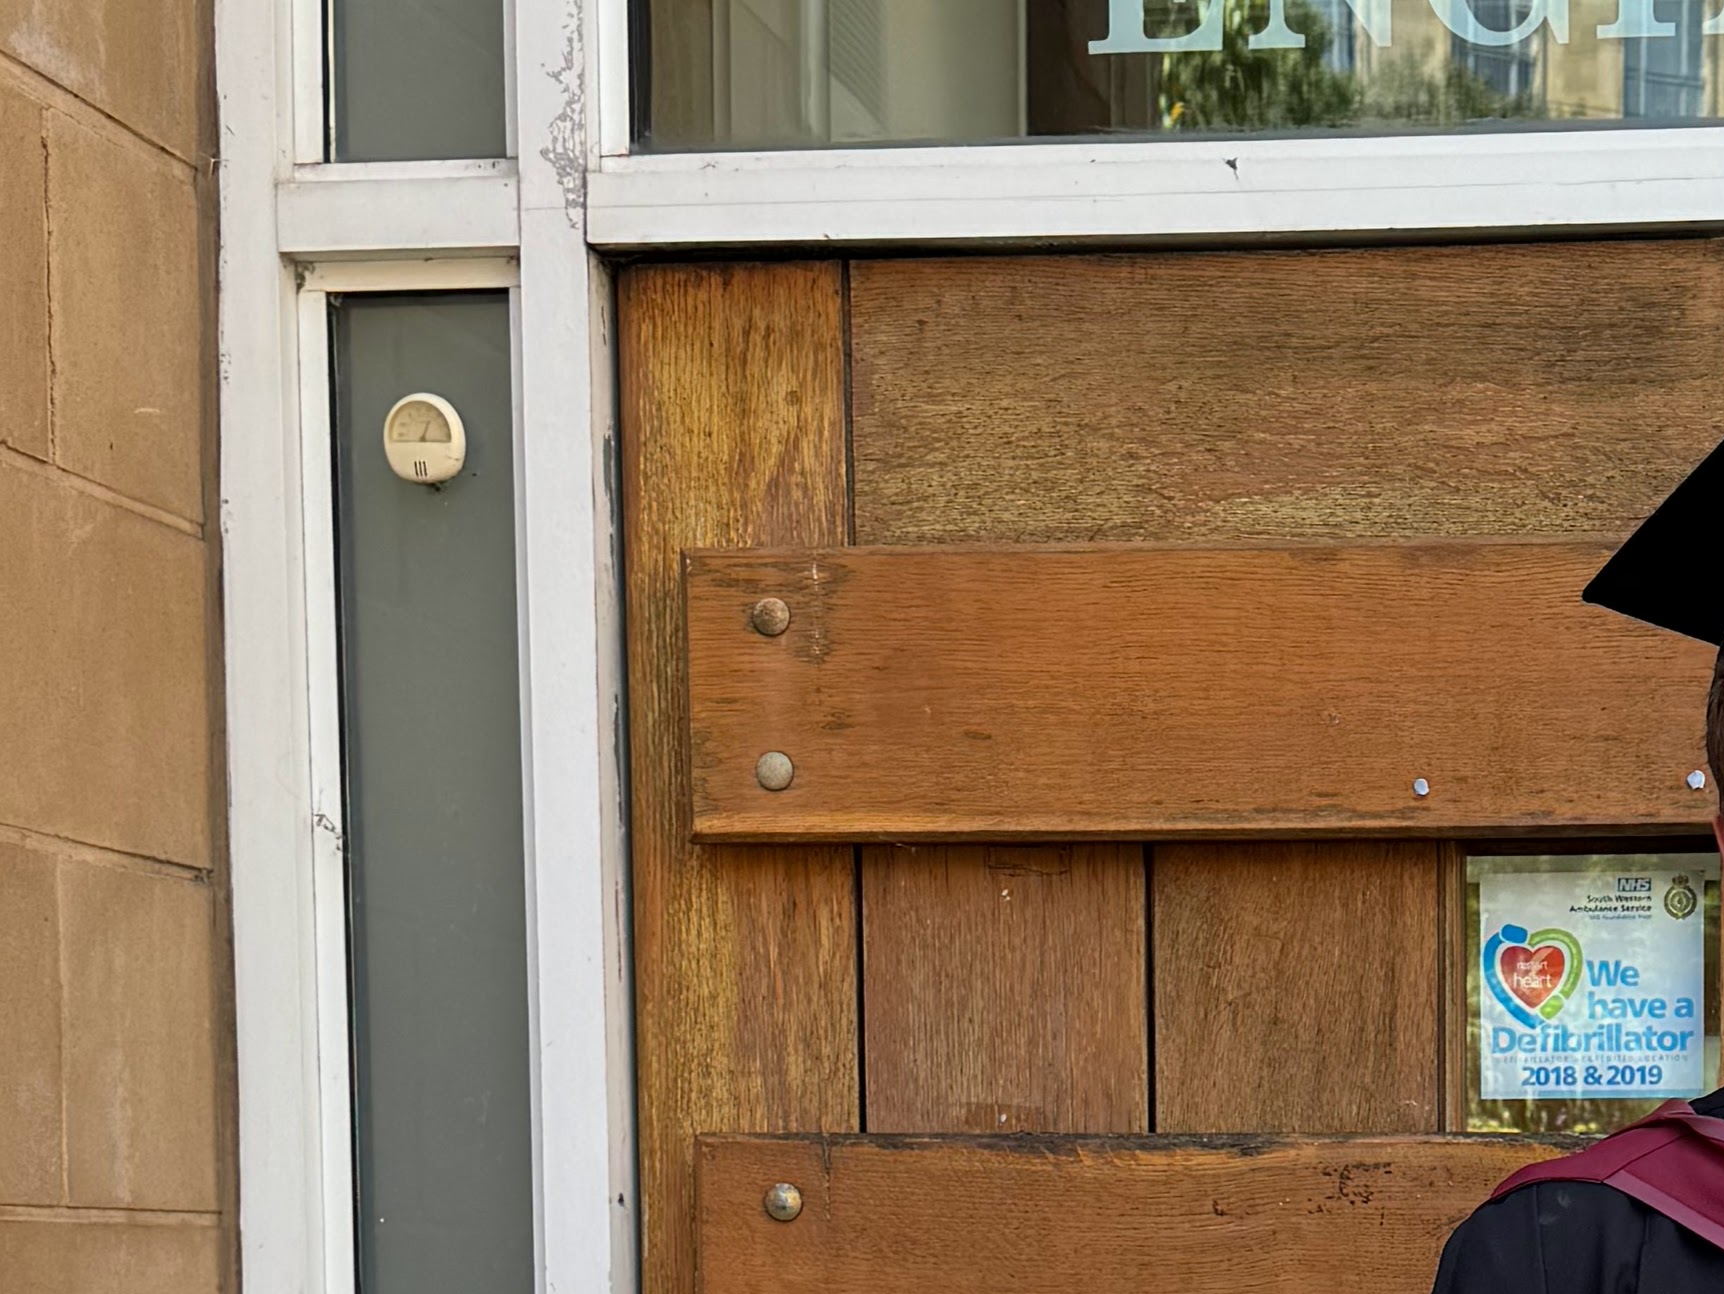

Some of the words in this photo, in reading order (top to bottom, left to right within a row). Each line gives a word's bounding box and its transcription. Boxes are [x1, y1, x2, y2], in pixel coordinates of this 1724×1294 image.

[1619, 878, 1650, 891] NHS
[1621, 904, 1652, 912] Service
[1513, 972, 1552, 989] heart
[1586, 960, 1640, 986] We
[1587, 991, 1667, 1019] have
[1674, 997, 1694, 1018] a
[1492, 1024, 1694, 1054] Defibrillator
[1521, 1065, 1577, 1087] 2018
[1583, 1065, 1603, 1086] &
[1606, 1064, 1663, 1086] 2019
